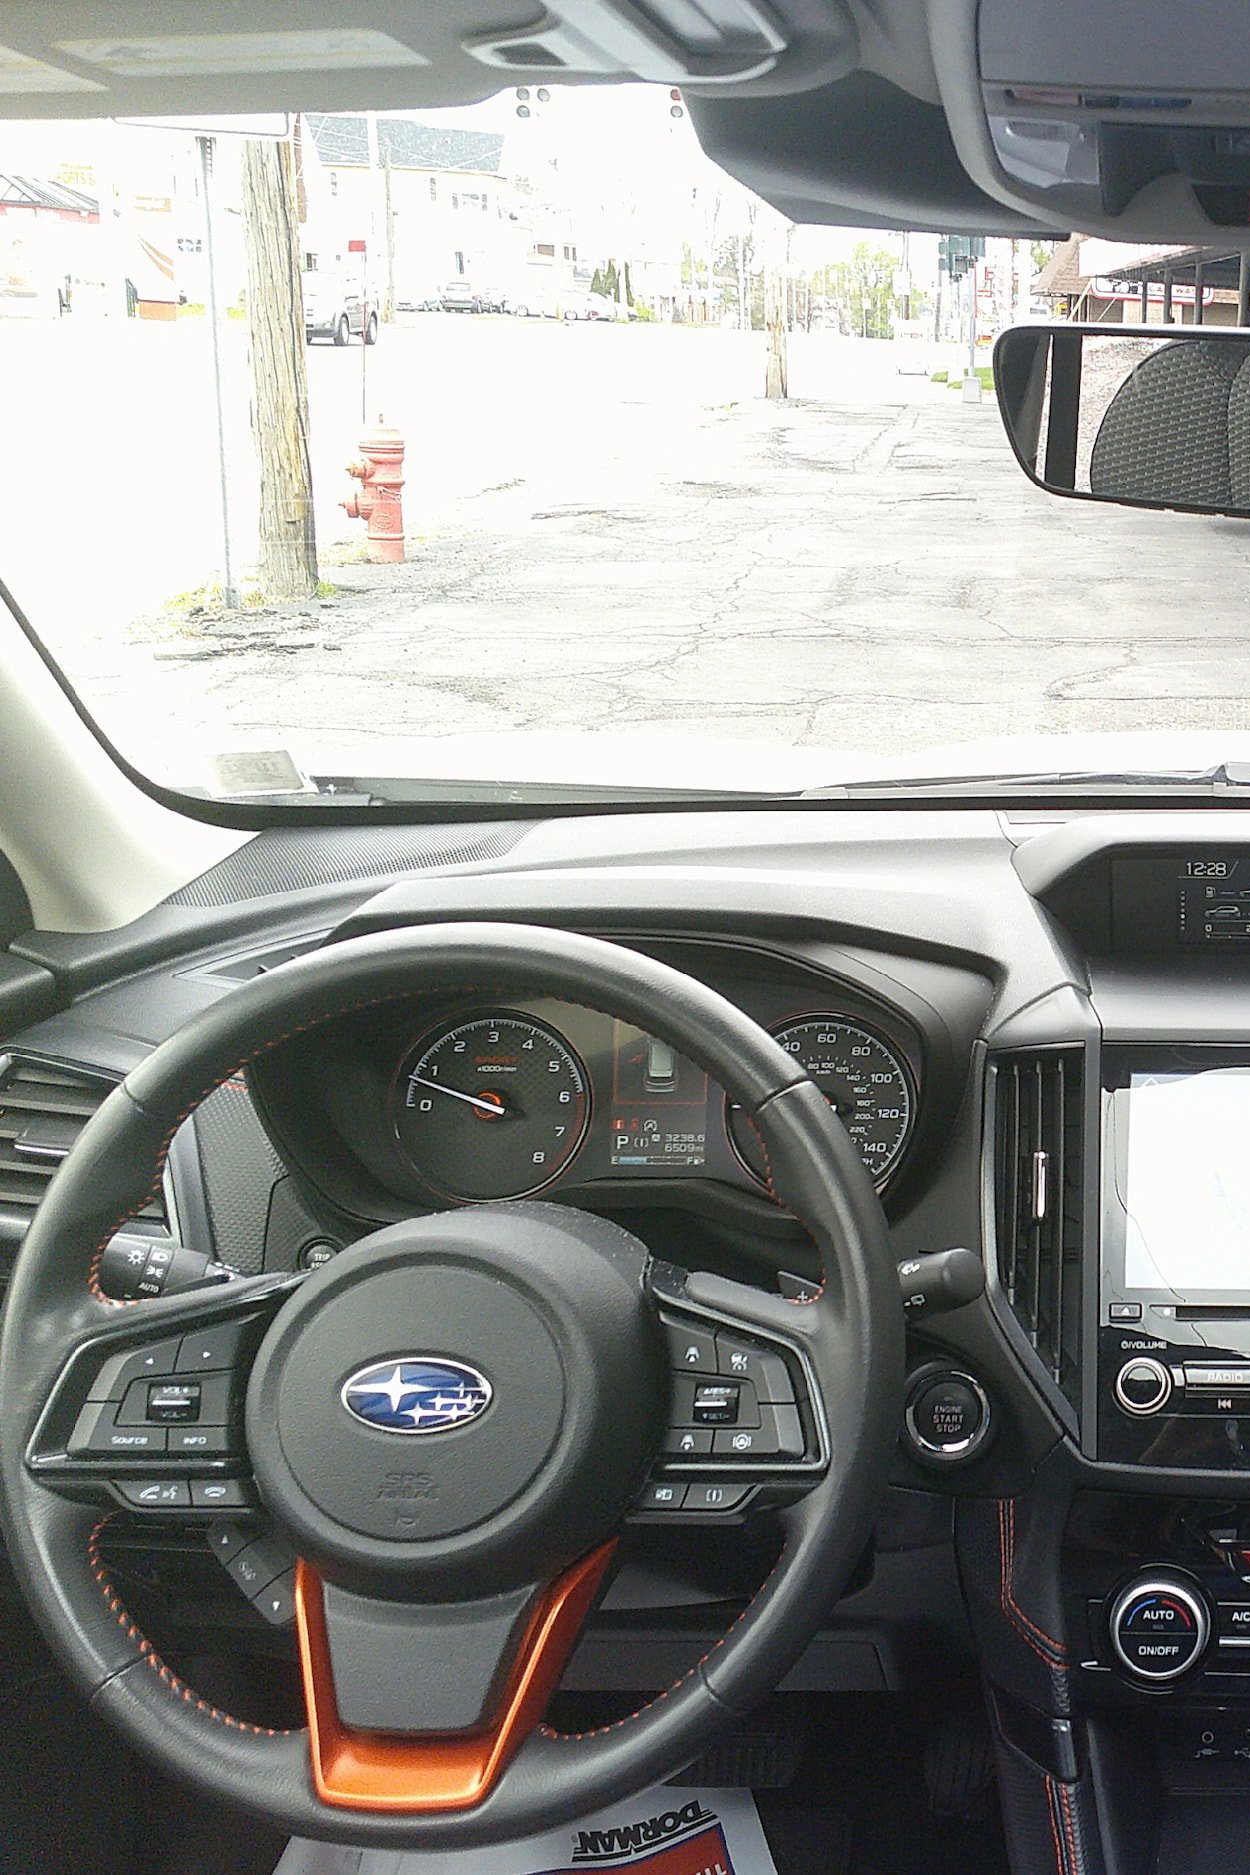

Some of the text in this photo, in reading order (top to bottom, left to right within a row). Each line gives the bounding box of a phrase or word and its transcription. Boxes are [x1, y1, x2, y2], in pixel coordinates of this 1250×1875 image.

[1186, 862, 1227, 876] 12:28
[488, 1031, 500, 1043] 3
[817, 1033, 837, 1044] 60
[453, 1040, 467, 1053] 2
[521, 1039, 534, 1050] 4
[782, 1041, 801, 1052] 40
[851, 1046, 871, 1057] 80
[431, 1065, 439, 1077] 1
[548, 1060, 561, 1073] 5
[870, 1073, 893, 1084] 100
[559, 1091, 571, 1104] 6
[419, 1099, 433, 1112] 0
[877, 1108, 900, 1119] 120
[554, 1126, 566, 1137] 7
[616, 1135, 629, 1150] P
[664, 1133, 706, 1143] 3238.6
[664, 1143, 695, 1153] 6509
[863, 1142, 887, 1153] 140
[532, 1151, 545, 1164] 8
[1207, 1372, 1244, 1383] RADIO
[932, 1414, 964, 1424] START
[936, 1424, 962, 1433] STOP
[1142, 1610, 1175, 1621] AUTO
[1137, 1645, 1180, 1656] ON/OFF
[574, 1800, 702, 1854] DORMAN
